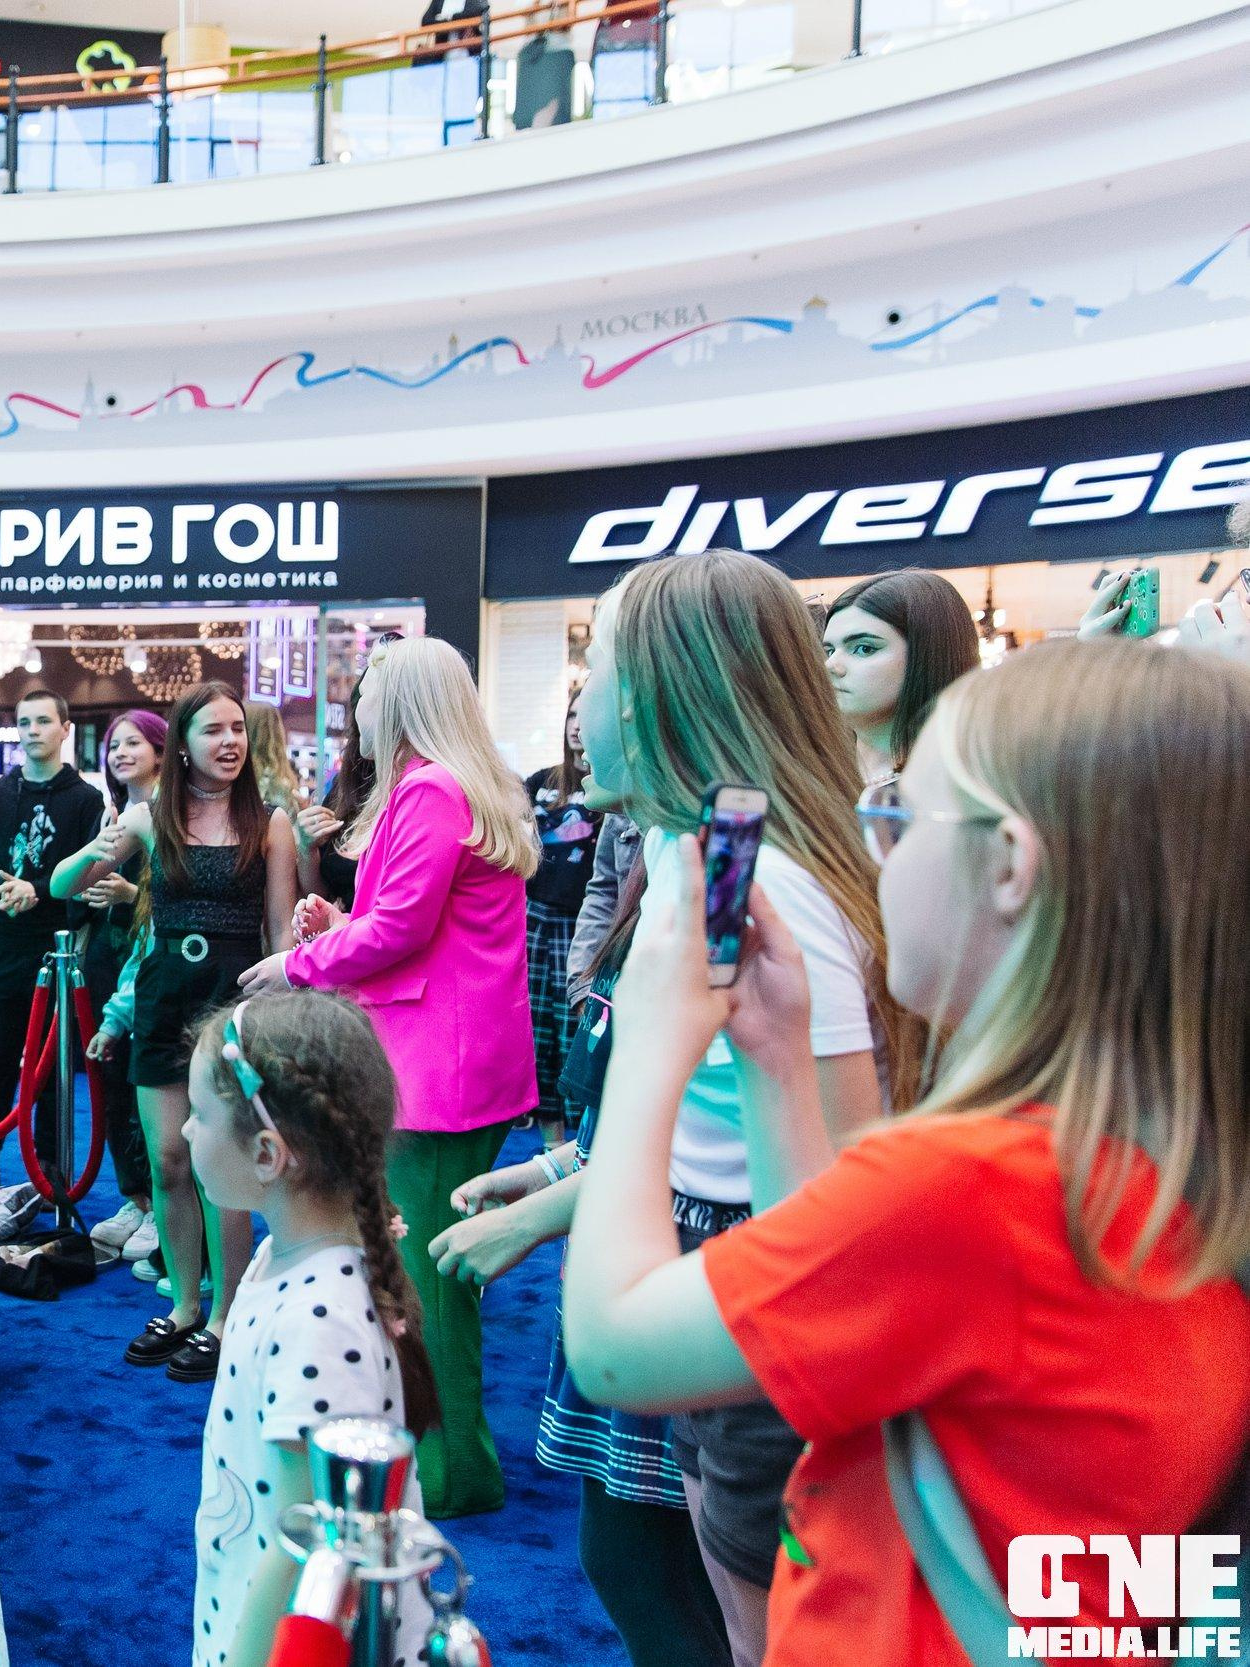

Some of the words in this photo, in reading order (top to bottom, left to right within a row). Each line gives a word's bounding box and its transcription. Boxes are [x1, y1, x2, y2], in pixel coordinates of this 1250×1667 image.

[580, 302, 709, 340] МОСКВА
[0, 507, 153, 567] РИВ
[171, 501, 340, 564] ГОШ
[0, 572, 163, 595] парфюмерия
[173, 574, 187, 588] и
[197, 570, 338, 589] косметика
